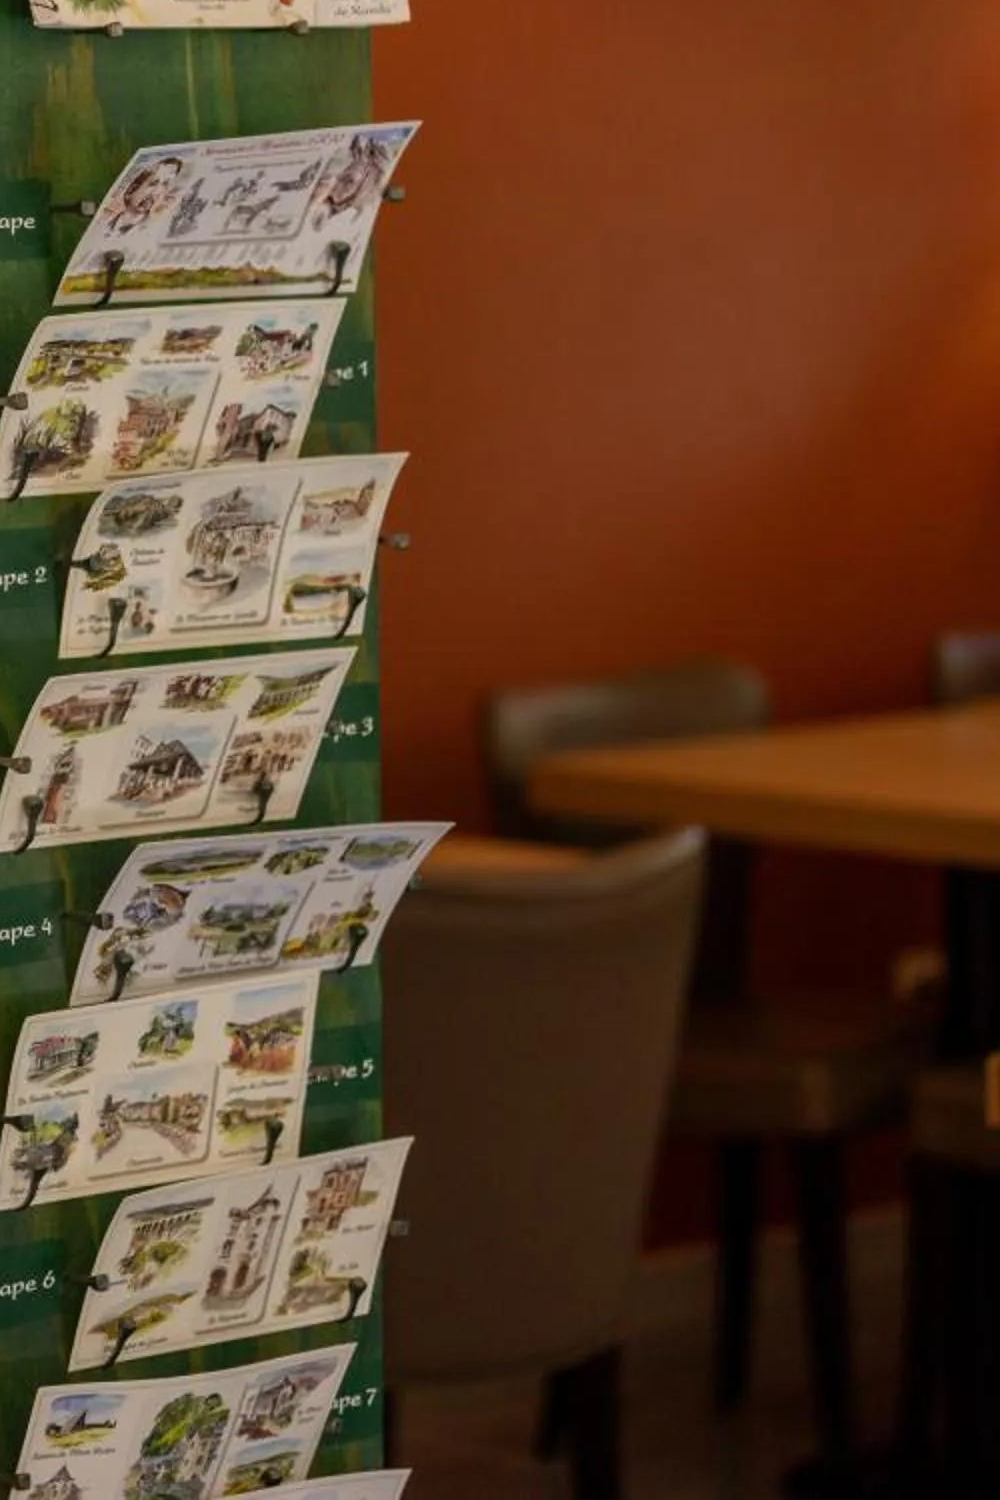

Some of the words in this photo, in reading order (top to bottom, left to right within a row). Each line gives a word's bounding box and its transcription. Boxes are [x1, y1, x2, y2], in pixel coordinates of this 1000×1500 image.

[34, 565, 47, 583] 2
[360, 715, 374, 737] 3
[41, 917, 53, 936] 4
[361, 1058, 374, 1079] 5
[43, 1269, 56, 1289] 6
[365, 1387, 377, 1408] 7
